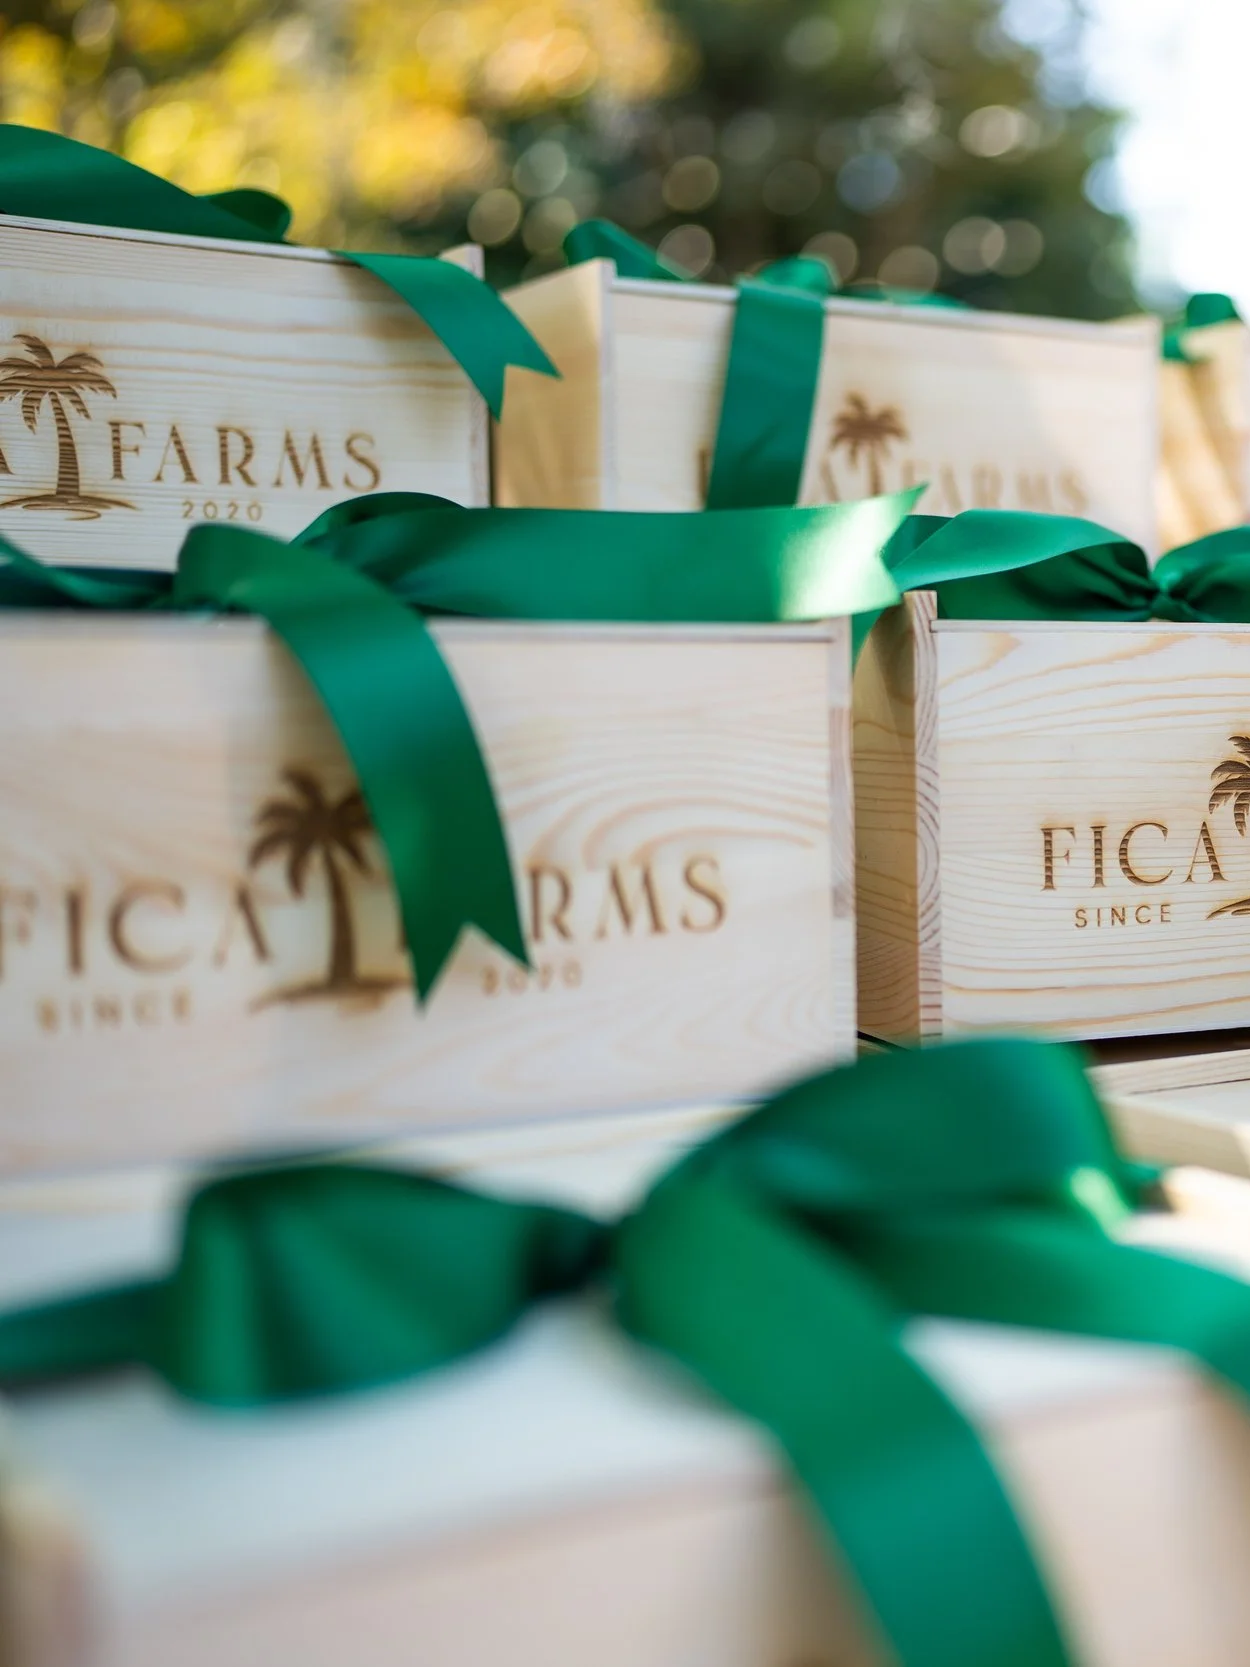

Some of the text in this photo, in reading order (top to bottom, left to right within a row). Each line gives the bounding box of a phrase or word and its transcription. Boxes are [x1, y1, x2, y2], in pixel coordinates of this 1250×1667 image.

[108, 420, 382, 493] FARMS
[181, 500, 263, 523] 2020
[1040, 821, 1229, 892] FICA
[1074, 904, 1172, 929] SINCE
